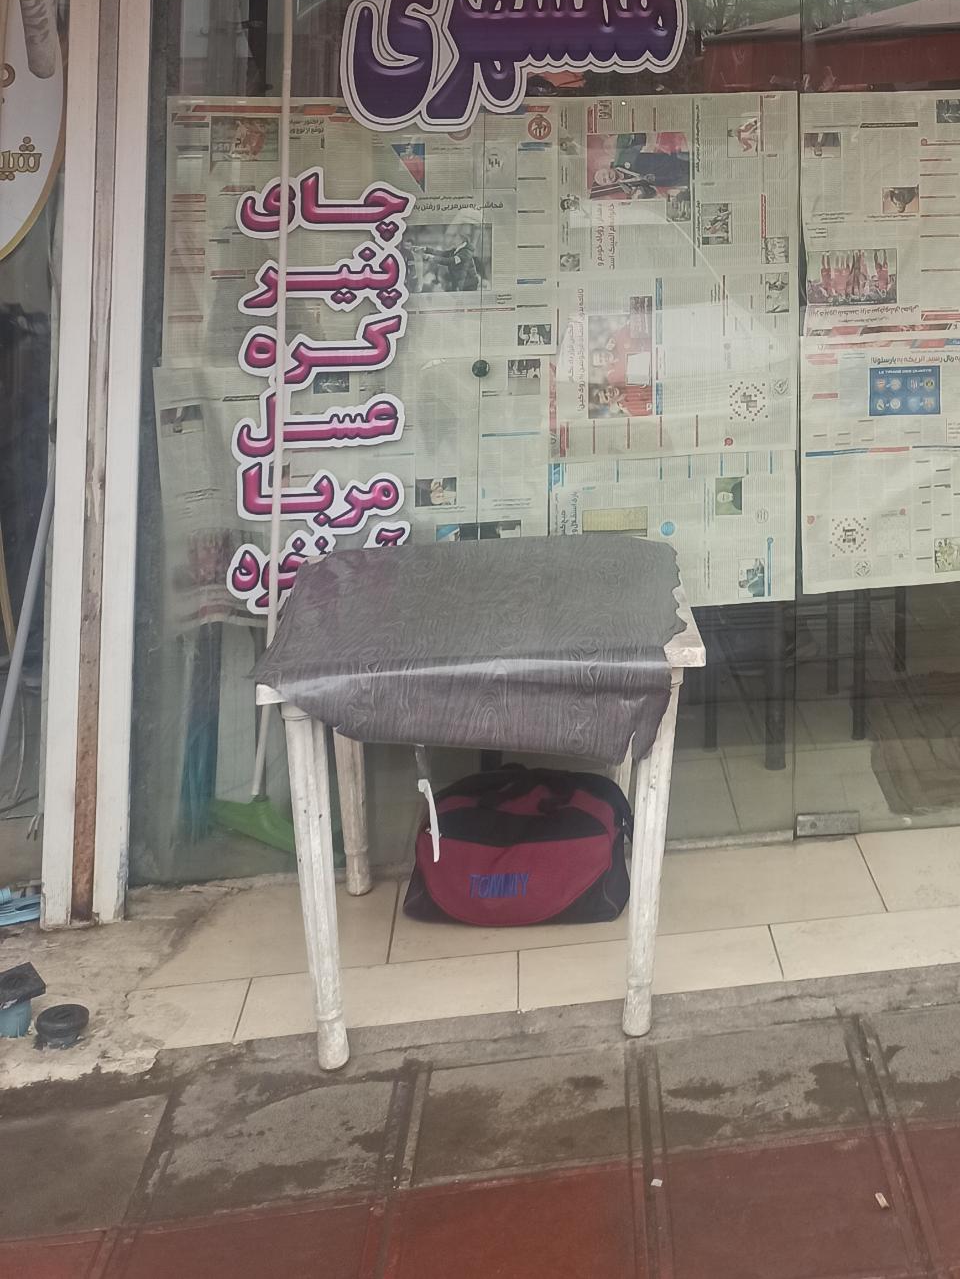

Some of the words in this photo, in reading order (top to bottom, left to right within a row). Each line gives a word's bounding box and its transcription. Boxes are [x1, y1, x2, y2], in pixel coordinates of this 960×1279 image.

[241, 171, 410, 241] چای
[244, 245, 400, 309] پنیر
[244, 316, 401, 384] کره
[237, 392, 398, 457] عسل
[243, 462, 399, 528] مربا
[469, 874, 528, 898] TOMMY
